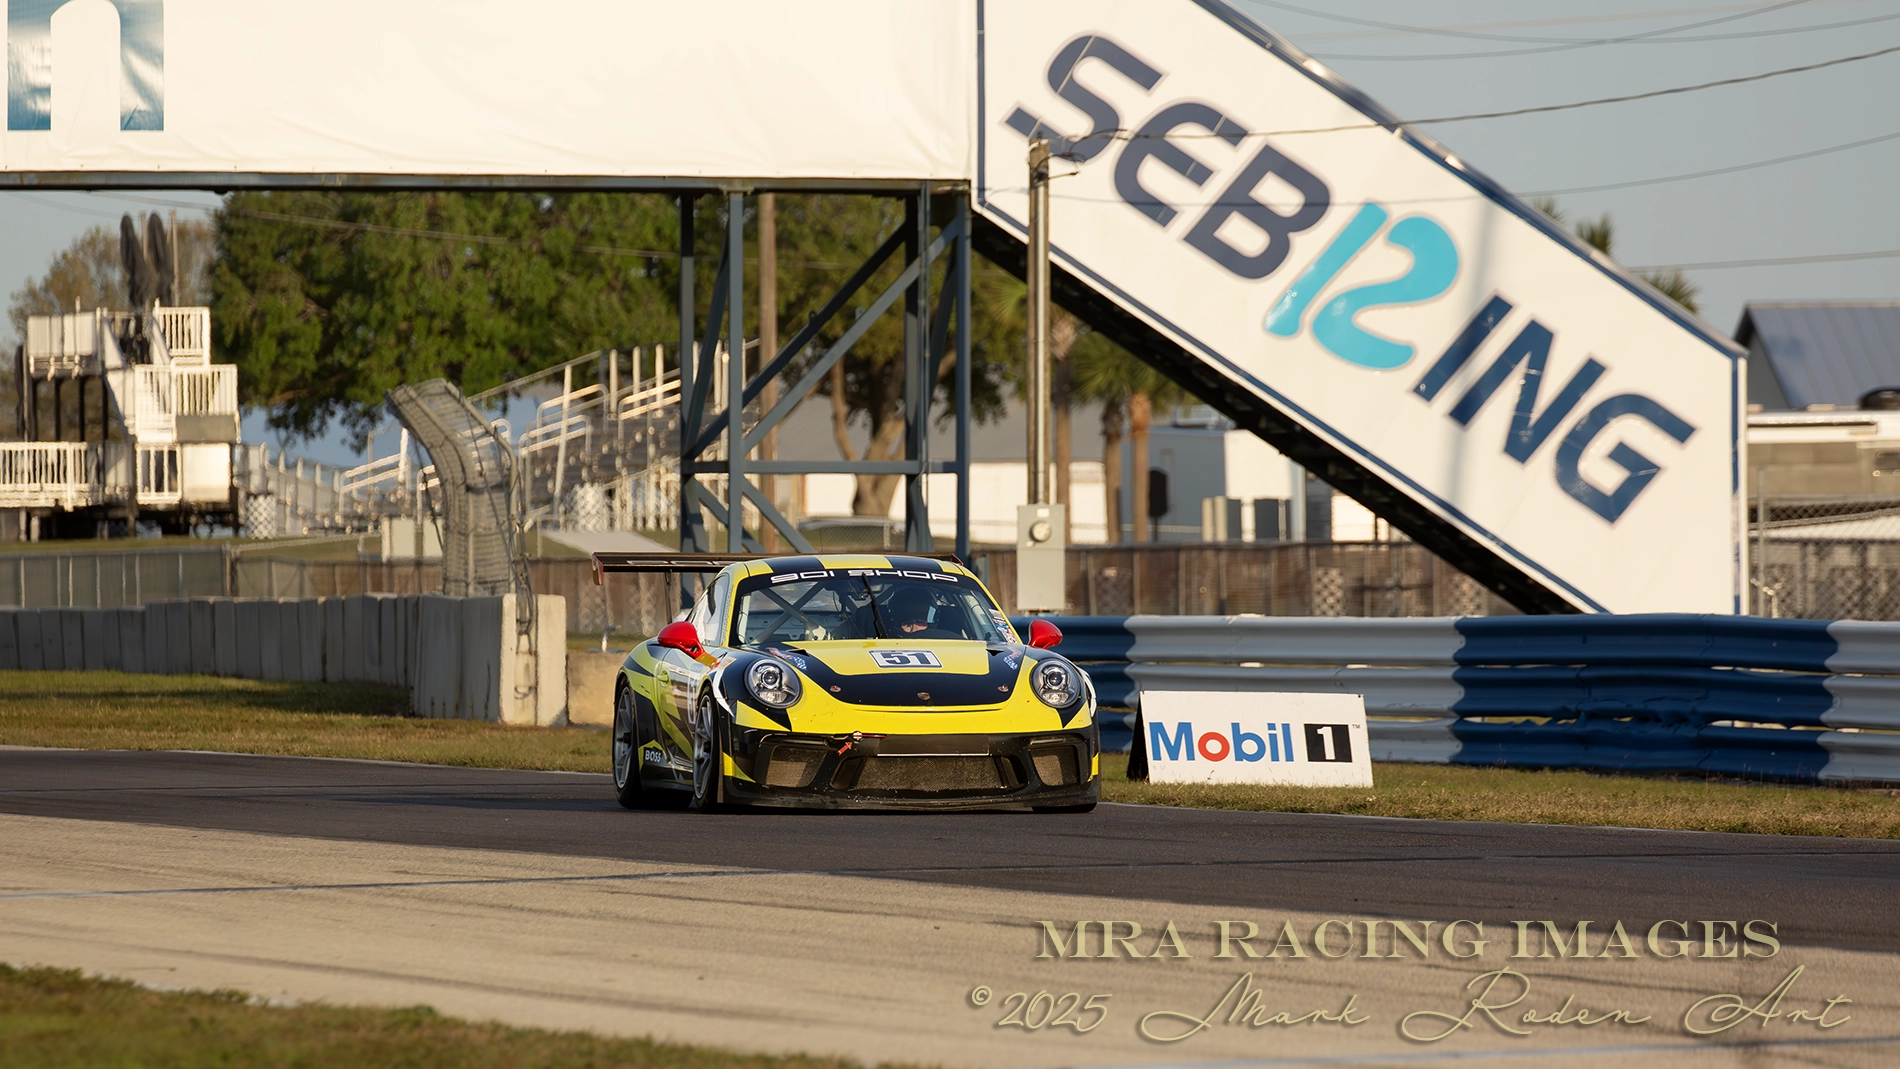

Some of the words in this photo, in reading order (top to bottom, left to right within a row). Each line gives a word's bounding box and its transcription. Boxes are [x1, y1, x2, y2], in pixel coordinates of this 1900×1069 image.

[848, 570, 958, 582] SHOP
[880, 652, 931, 665] 51
[1149, 721, 1294, 762] Mobil
[645, 749, 662, 763] BOSS
